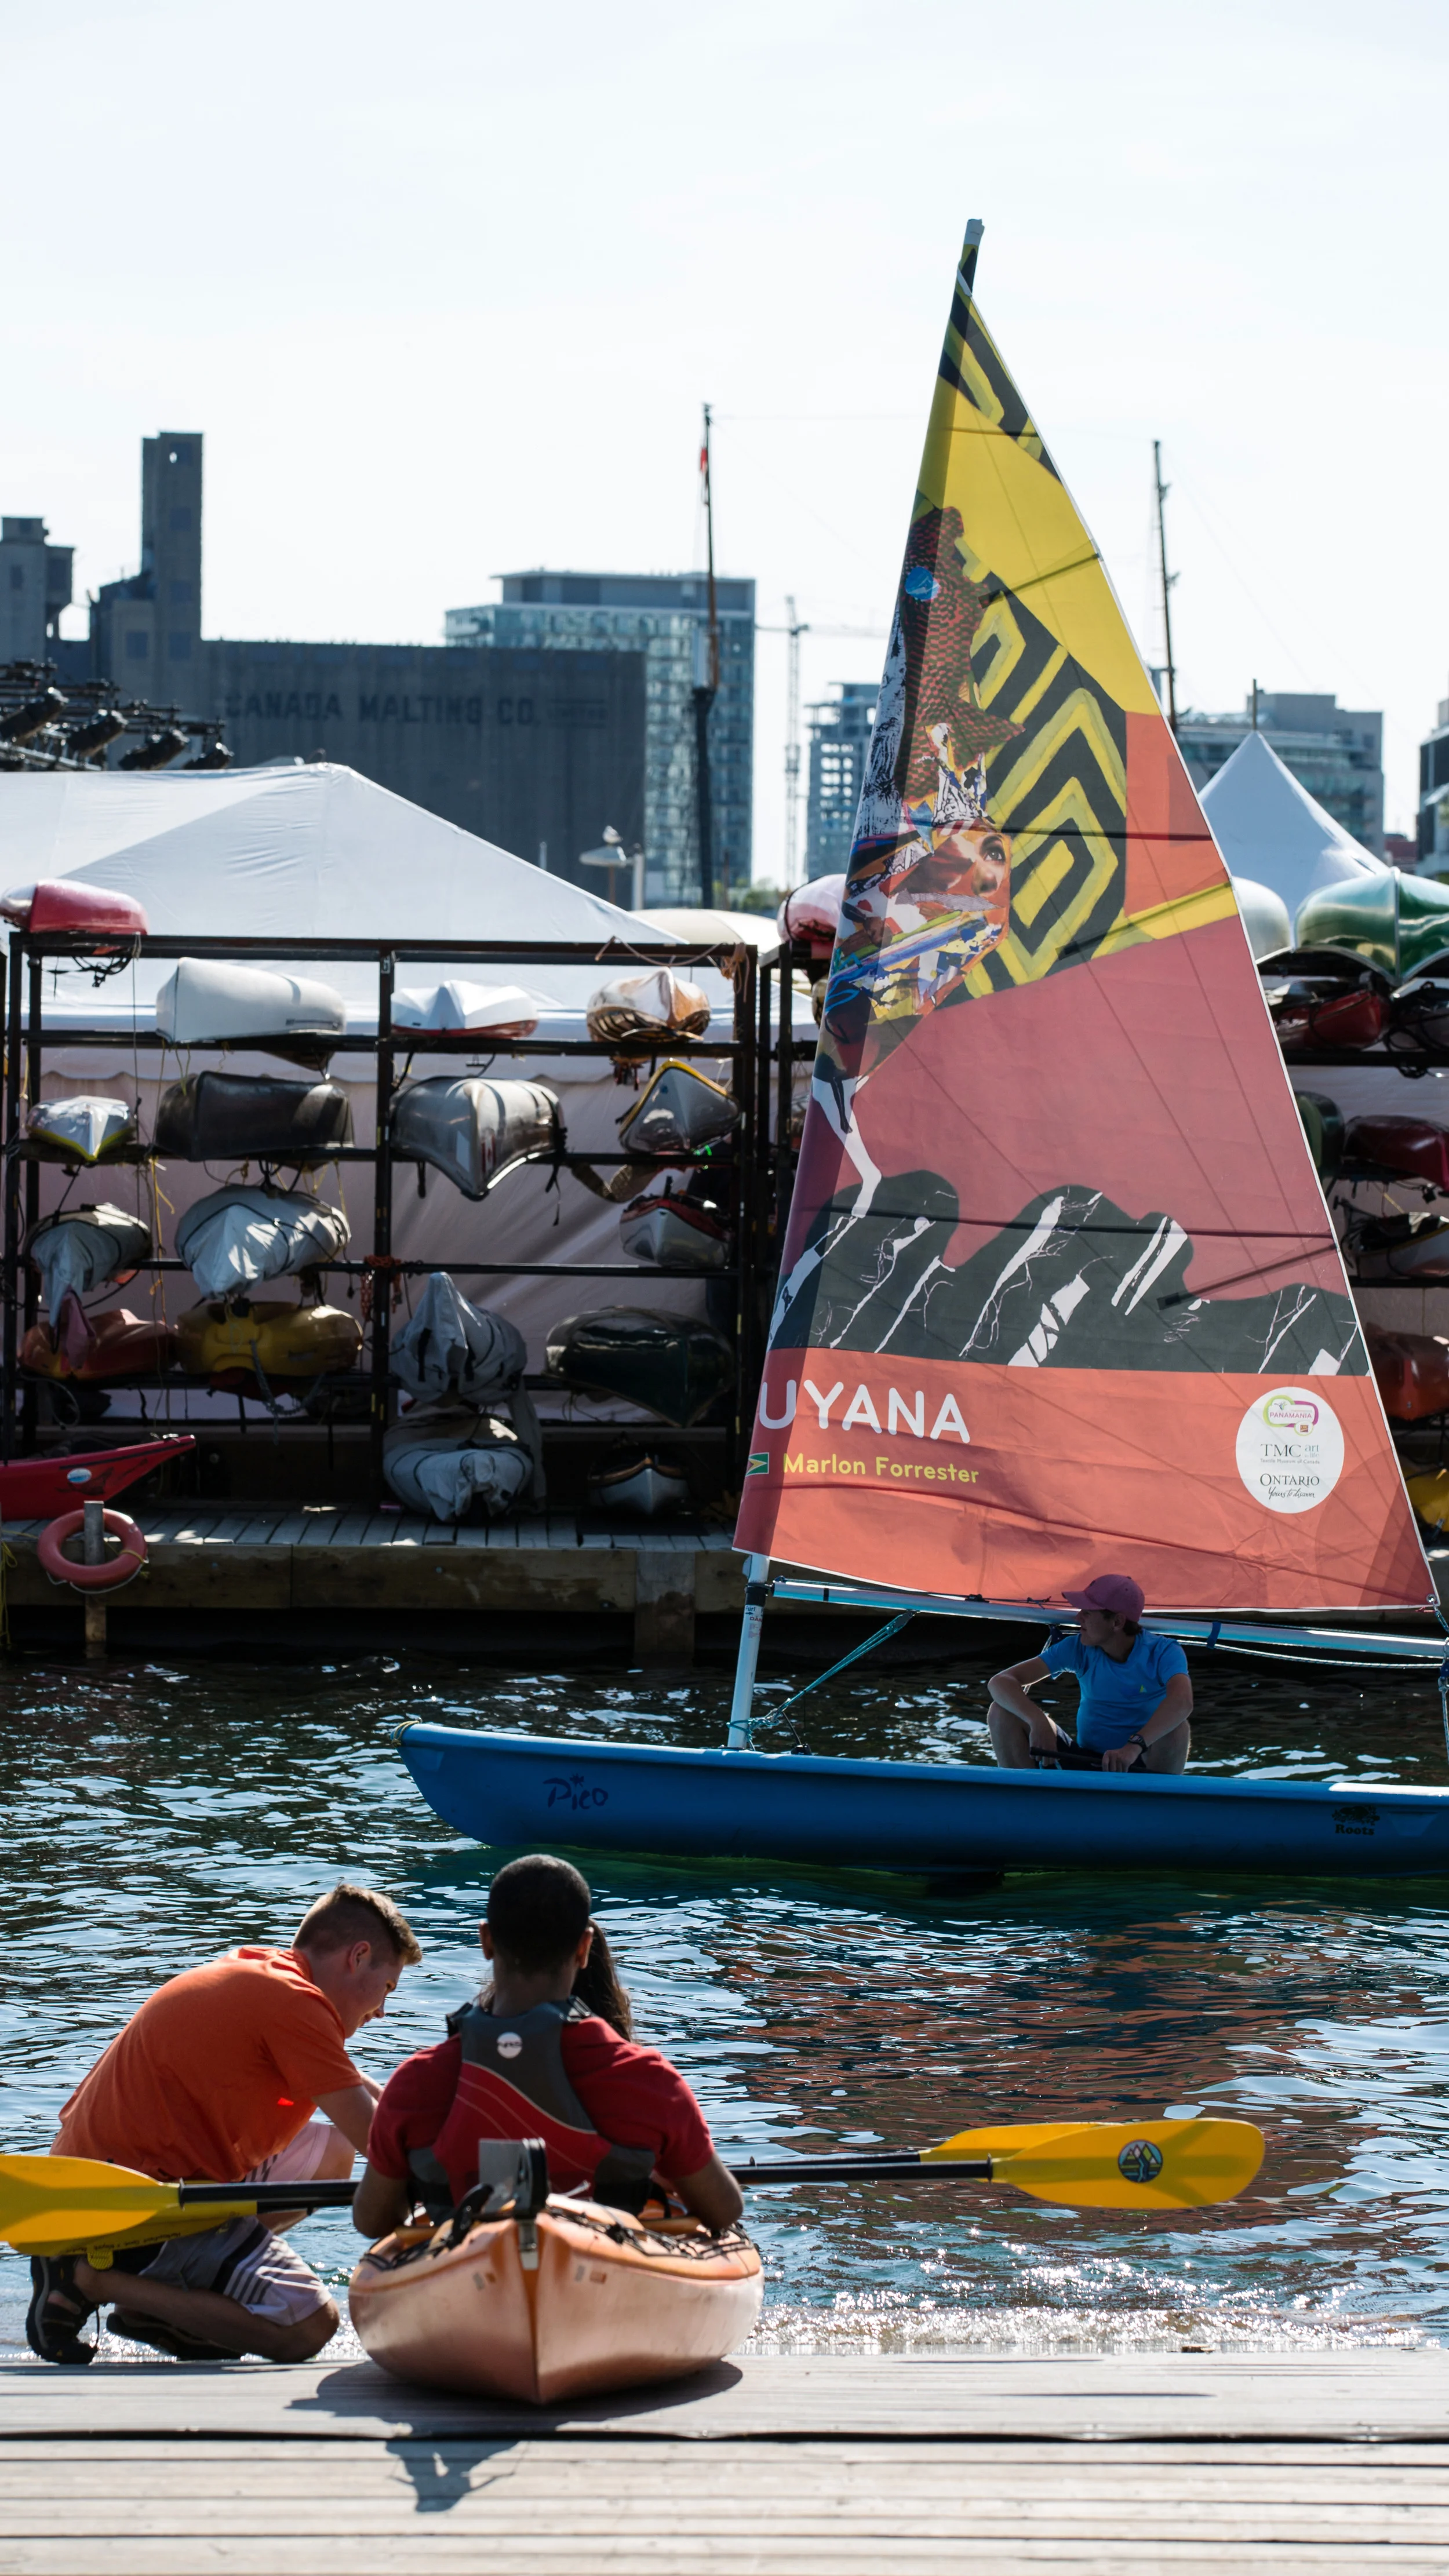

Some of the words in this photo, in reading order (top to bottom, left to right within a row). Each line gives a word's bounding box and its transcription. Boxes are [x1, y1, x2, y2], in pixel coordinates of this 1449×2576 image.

[225, 691, 343, 722] CANADA
[359, 693, 483, 725] MALTING
[759, 1379, 970, 1443] UYANA
[1260, 1444, 1301, 1458] TMC
[783, 1453, 866, 1475] Marlon
[875, 1456, 980, 1484] Forrester
[1268, 1486, 1286, 1500] Yours
[1286, 1488, 1297, 1498] to
[1293, 1488, 1316, 1498] discover
[543, 1773, 609, 1810] Pico
[1335, 1824, 1375, 1835] Roots
